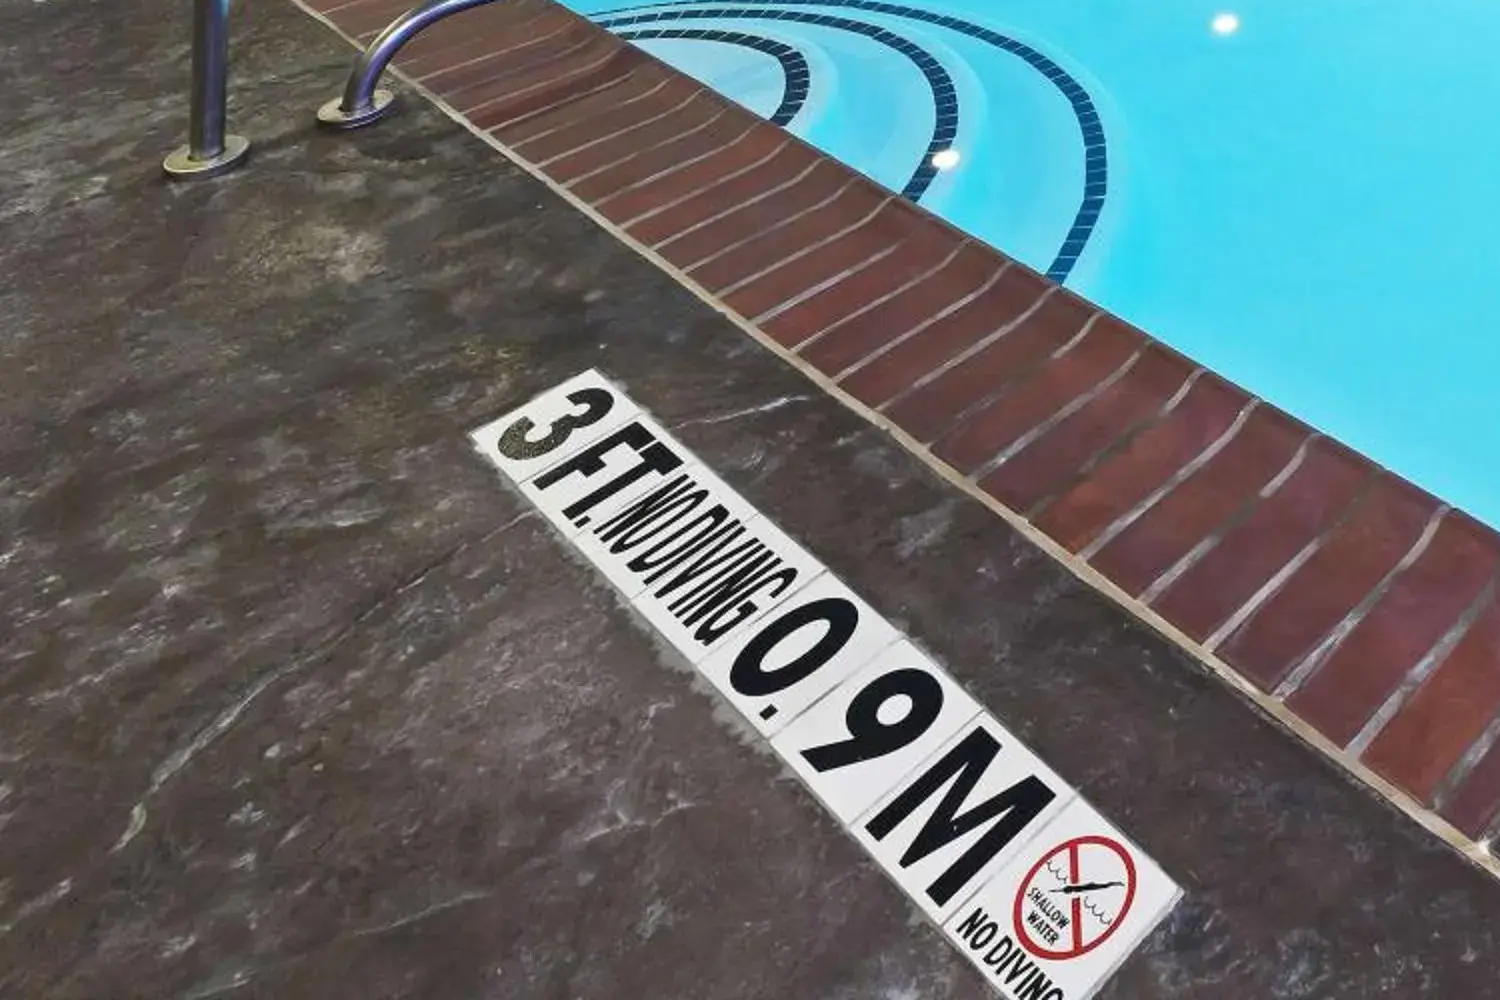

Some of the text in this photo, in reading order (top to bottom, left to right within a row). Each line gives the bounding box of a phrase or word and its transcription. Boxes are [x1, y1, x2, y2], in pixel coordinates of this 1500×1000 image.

[592, 473, 799, 647] NO DIVING
[956, 907, 999, 951] NO
[1026, 887, 1071, 930] SHALLOW
[1026, 909, 1060, 947] WATER
